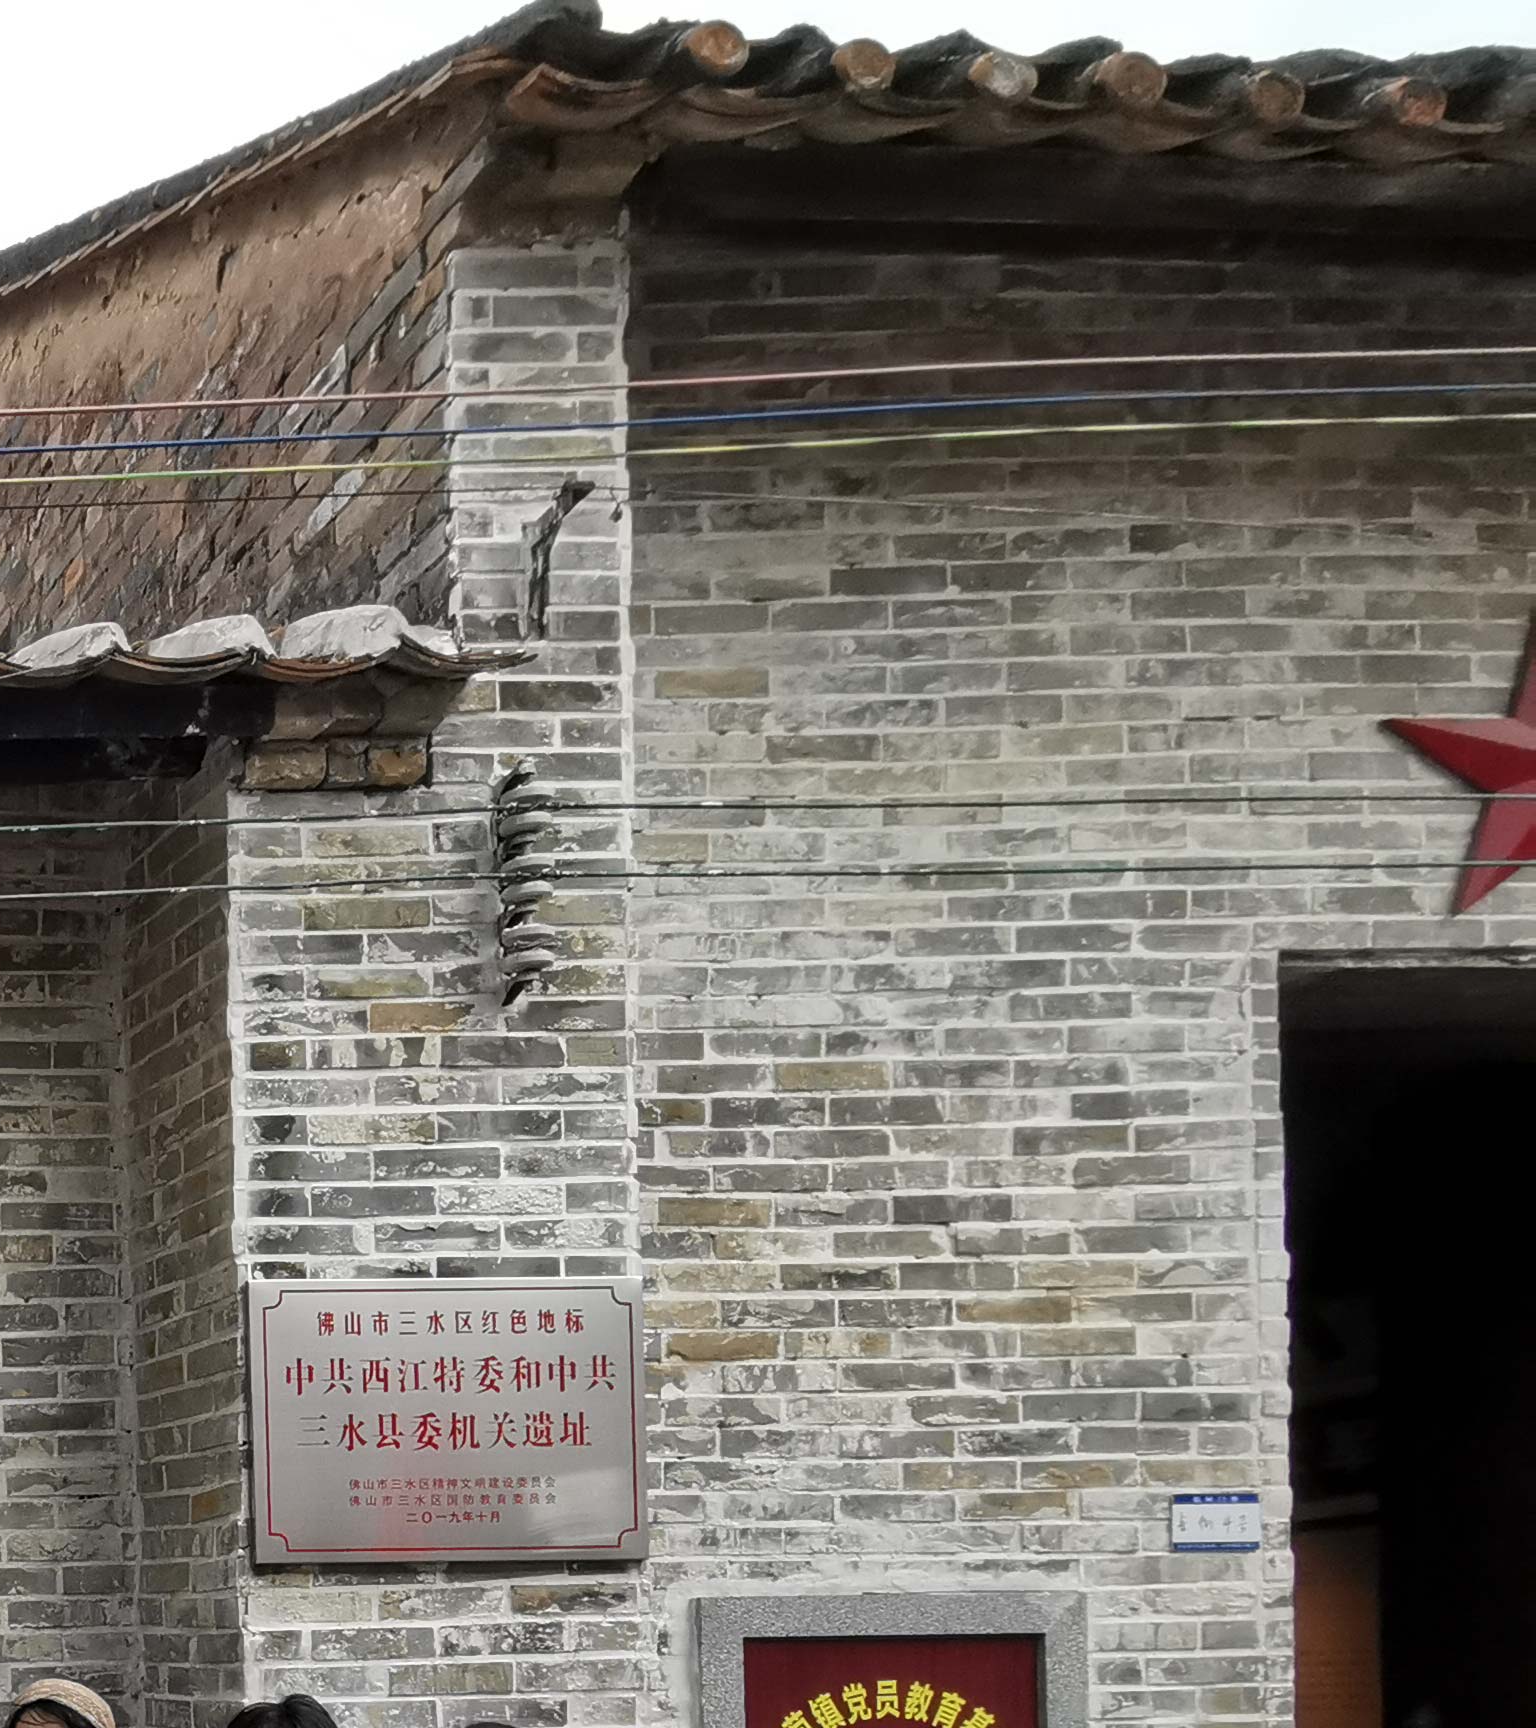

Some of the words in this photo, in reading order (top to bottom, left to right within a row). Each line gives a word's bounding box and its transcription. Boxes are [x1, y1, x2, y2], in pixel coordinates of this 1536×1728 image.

[315, 1308, 586, 1337] 佛山市三水区红色地标
[284, 1354, 618, 1397] 中共西江特委和中共
[295, 1410, 594, 1453] 三水县委机关遗址
[348, 1476, 557, 1491] 佛山市三水区精神文明建设委员会
[348, 1493, 557, 1507] 佛山市三水区国防教育委员会
